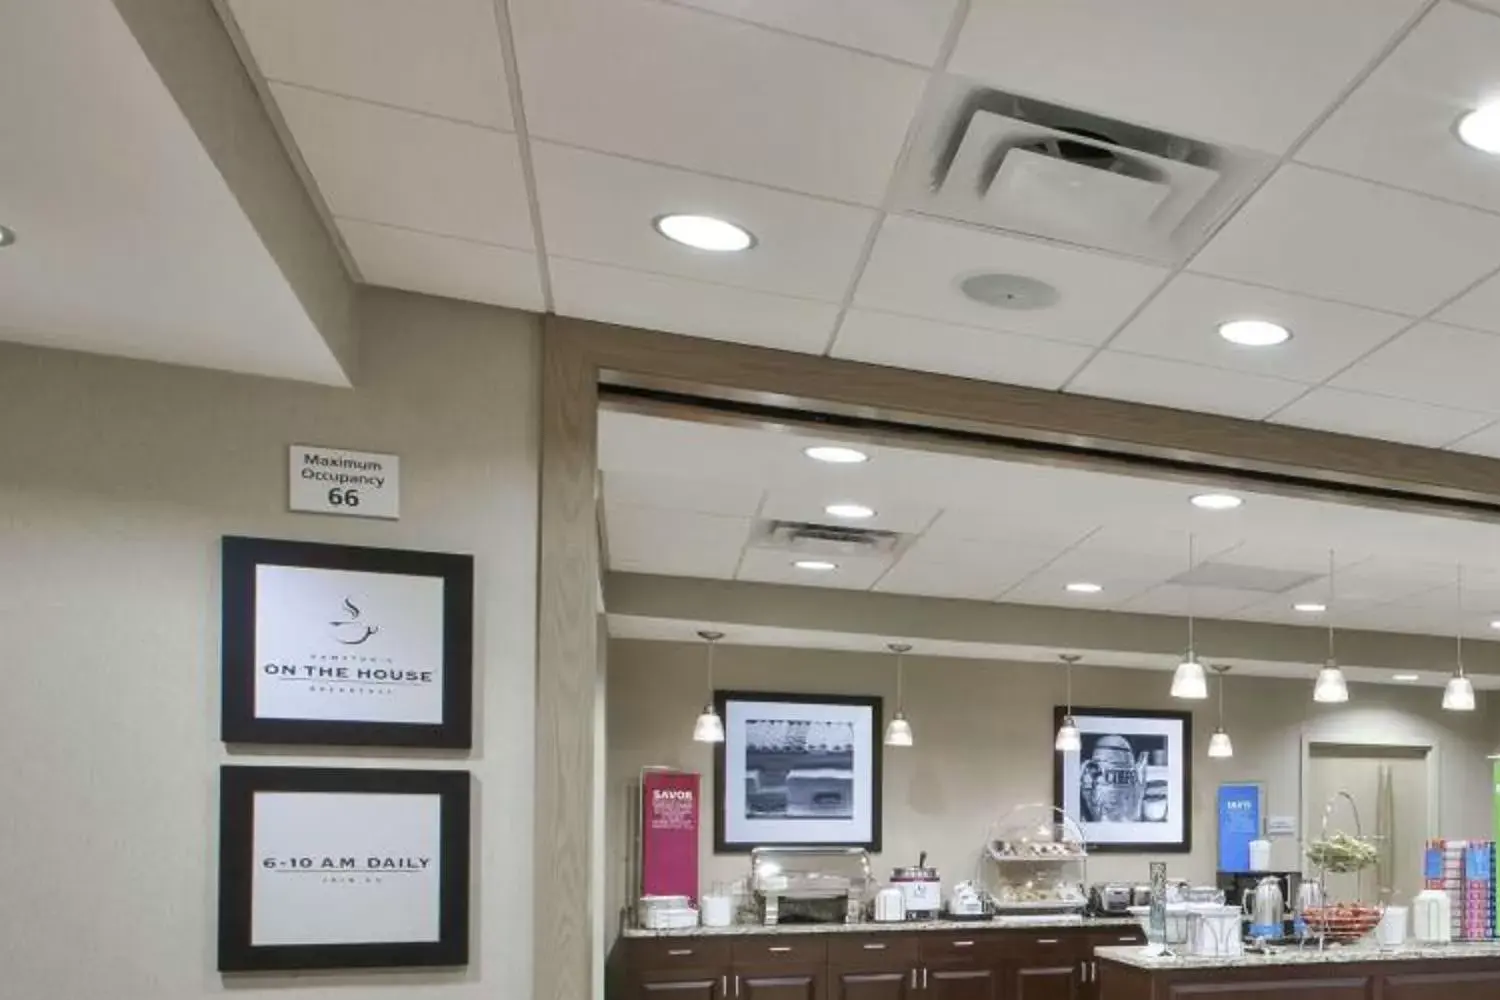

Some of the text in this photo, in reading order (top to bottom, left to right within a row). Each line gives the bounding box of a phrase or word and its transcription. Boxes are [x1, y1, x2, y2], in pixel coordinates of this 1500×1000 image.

[303, 453, 382, 471] Maximum
[301, 467, 385, 488] Occupancy
[328, 487, 359, 507] 66
[264, 663, 433, 683] ON THE HOUSE
[262, 857, 313, 869] 6-10
[366, 857, 431, 869] DAILY
